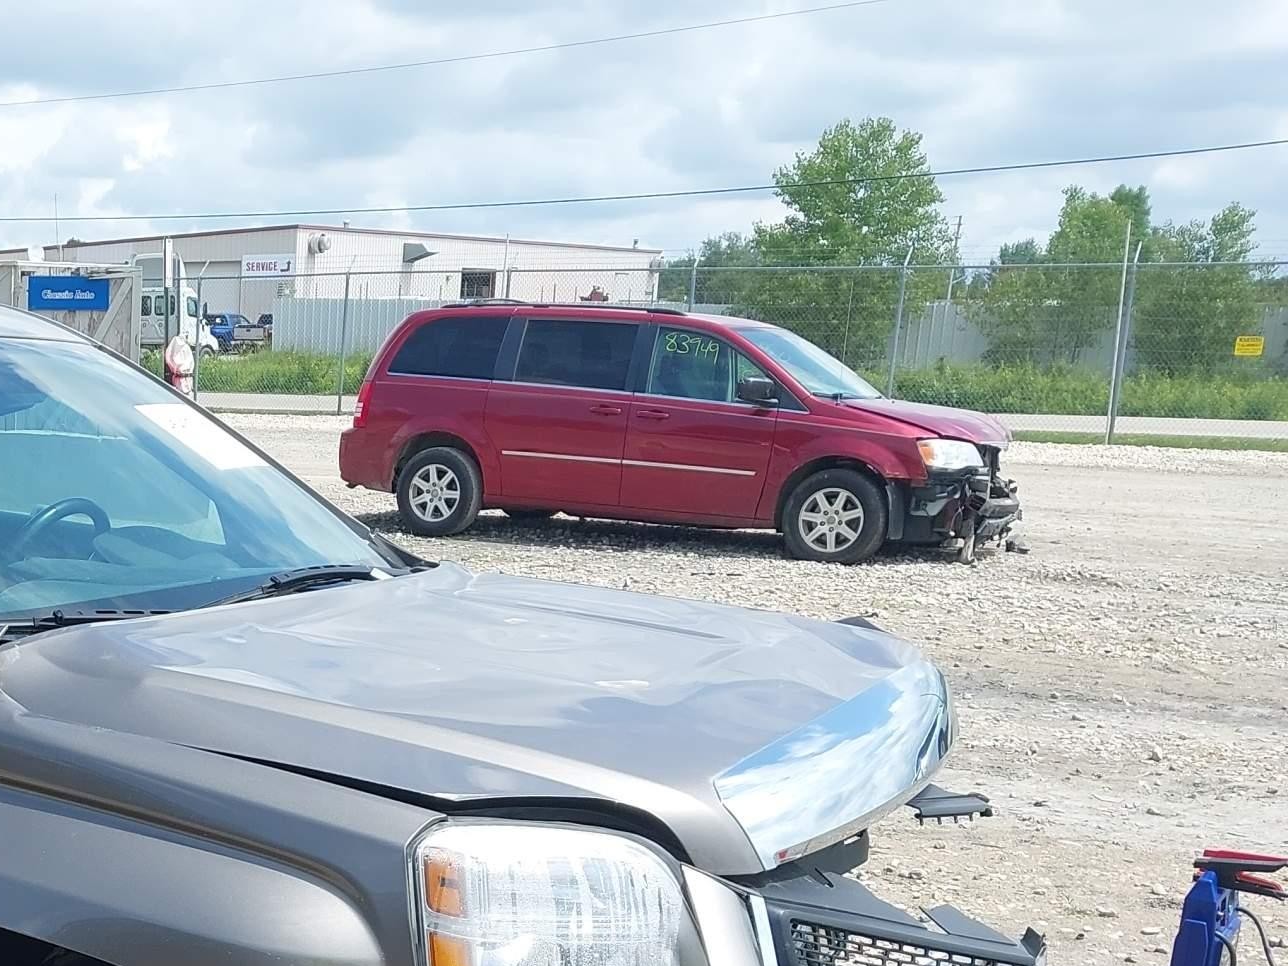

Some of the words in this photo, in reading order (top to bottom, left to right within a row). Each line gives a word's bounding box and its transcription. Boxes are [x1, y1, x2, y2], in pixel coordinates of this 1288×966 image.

[246, 261, 278, 272] SERVICE
[74, 289, 96, 299] Auto
[665, 331, 720, 365] 83949
